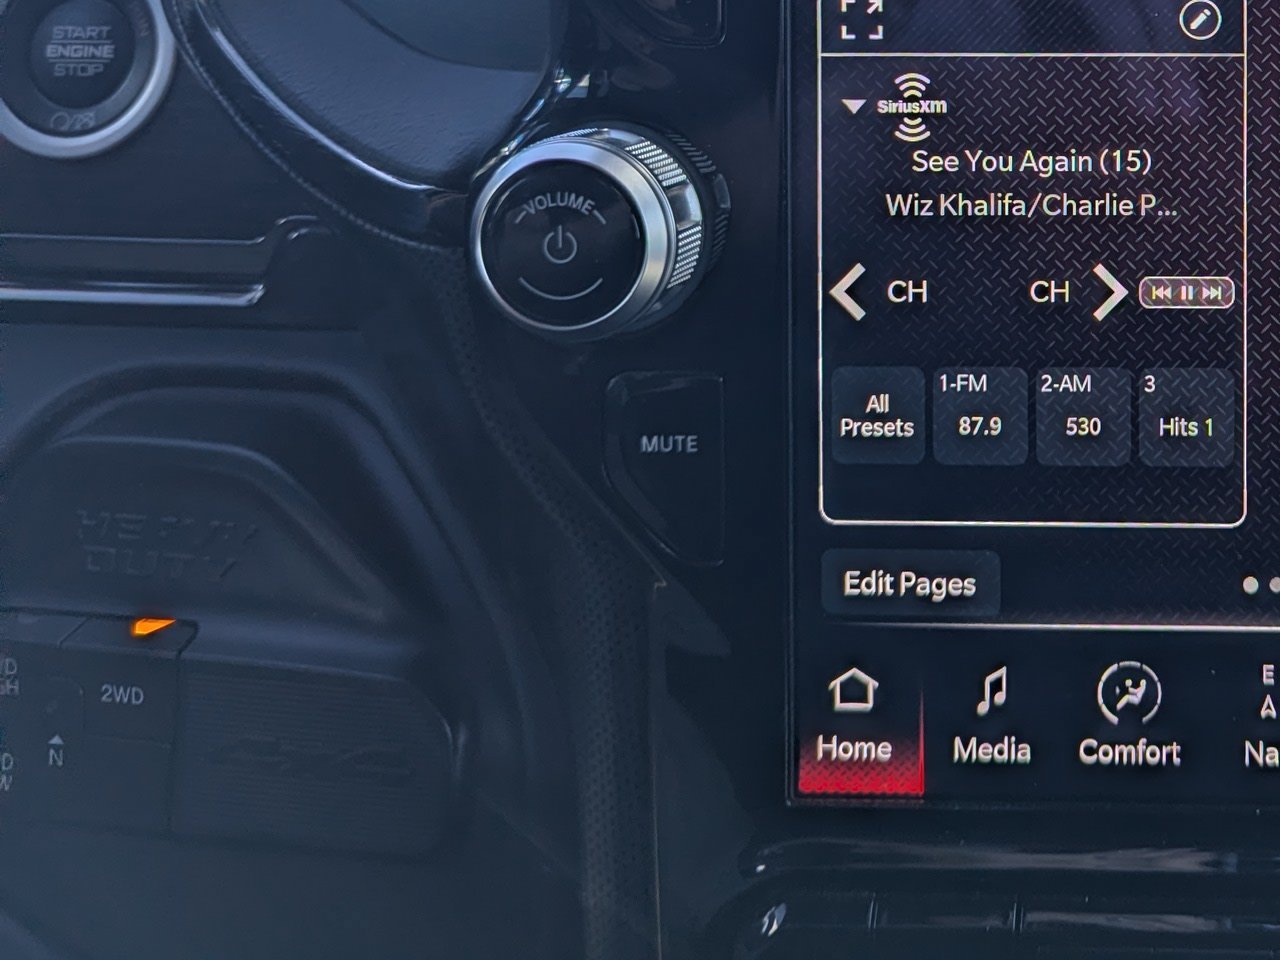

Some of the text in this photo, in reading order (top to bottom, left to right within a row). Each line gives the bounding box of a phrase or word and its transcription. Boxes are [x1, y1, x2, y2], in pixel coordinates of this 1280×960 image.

[53, 26, 111, 39] START
[46, 44, 115, 59] ENGINE
[53, 63, 104, 77] STOP
[911, 150, 1153, 178] See You Again (15)
[523, 191, 597, 215] VOLUME
[885, 195, 934, 217] Wiz
[939, 194, 1135, 220] Khalifa/Charlie
[887, 280, 928, 303] CH
[1029, 280, 1071, 303] CH
[939, 375, 987, 392] 1-FM
[1041, 375, 1092, 393] 2-AM
[1144, 376, 1156, 393] 3
[866, 394, 889, 413] All
[840, 419, 915, 438] Presets
[958, 417, 1002, 437] 87.9
[1065, 417, 1102, 437] 530
[1159, 418, 1214, 437] Hits 1
[641, 435, 698, 453] MUTE
[843, 571, 977, 602] Edit Pages
[1262, 664, 1275, 685] E
[101, 684, 144, 705] 2WD
[48, 749, 63, 767] N
[816, 735, 893, 763] Home
[953, 736, 1032, 764] Media
[1079, 738, 1182, 767] Comfort
